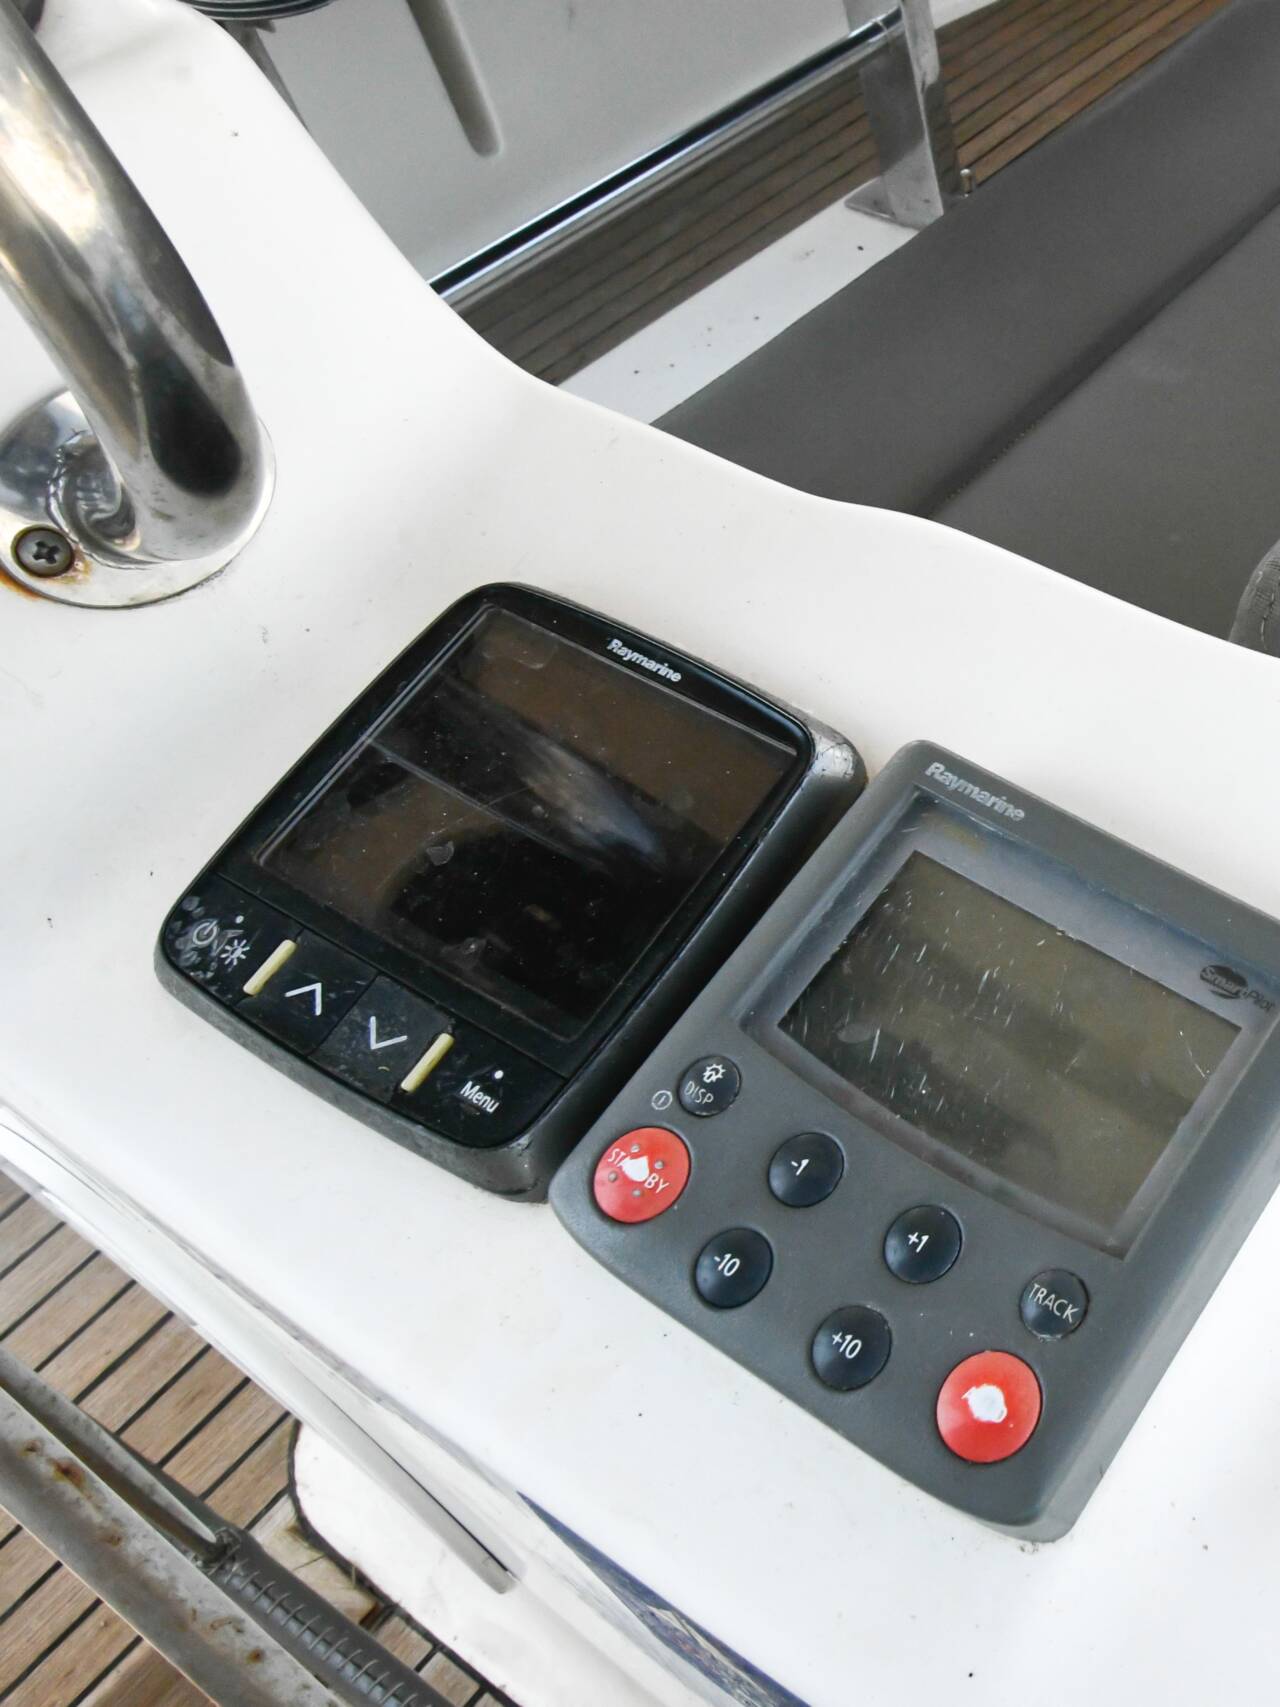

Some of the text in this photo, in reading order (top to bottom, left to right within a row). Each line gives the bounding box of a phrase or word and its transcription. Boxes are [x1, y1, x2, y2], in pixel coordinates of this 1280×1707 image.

[606, 638, 682, 683] Raymarine
[925, 762, 1025, 821] Raymarine
[460, 1080, 500, 1114] Menu
[684, 1081, 714, 1105] DISP
[607, 1148, 670, 1194] STBY
[791, 1158, 810, 1176] -1
[908, 1232, 930, 1253] +1
[714, 1253, 741, 1277] -10
[1028, 1283, 1080, 1324] TRACK
[832, 1332, 862, 1359] +10
